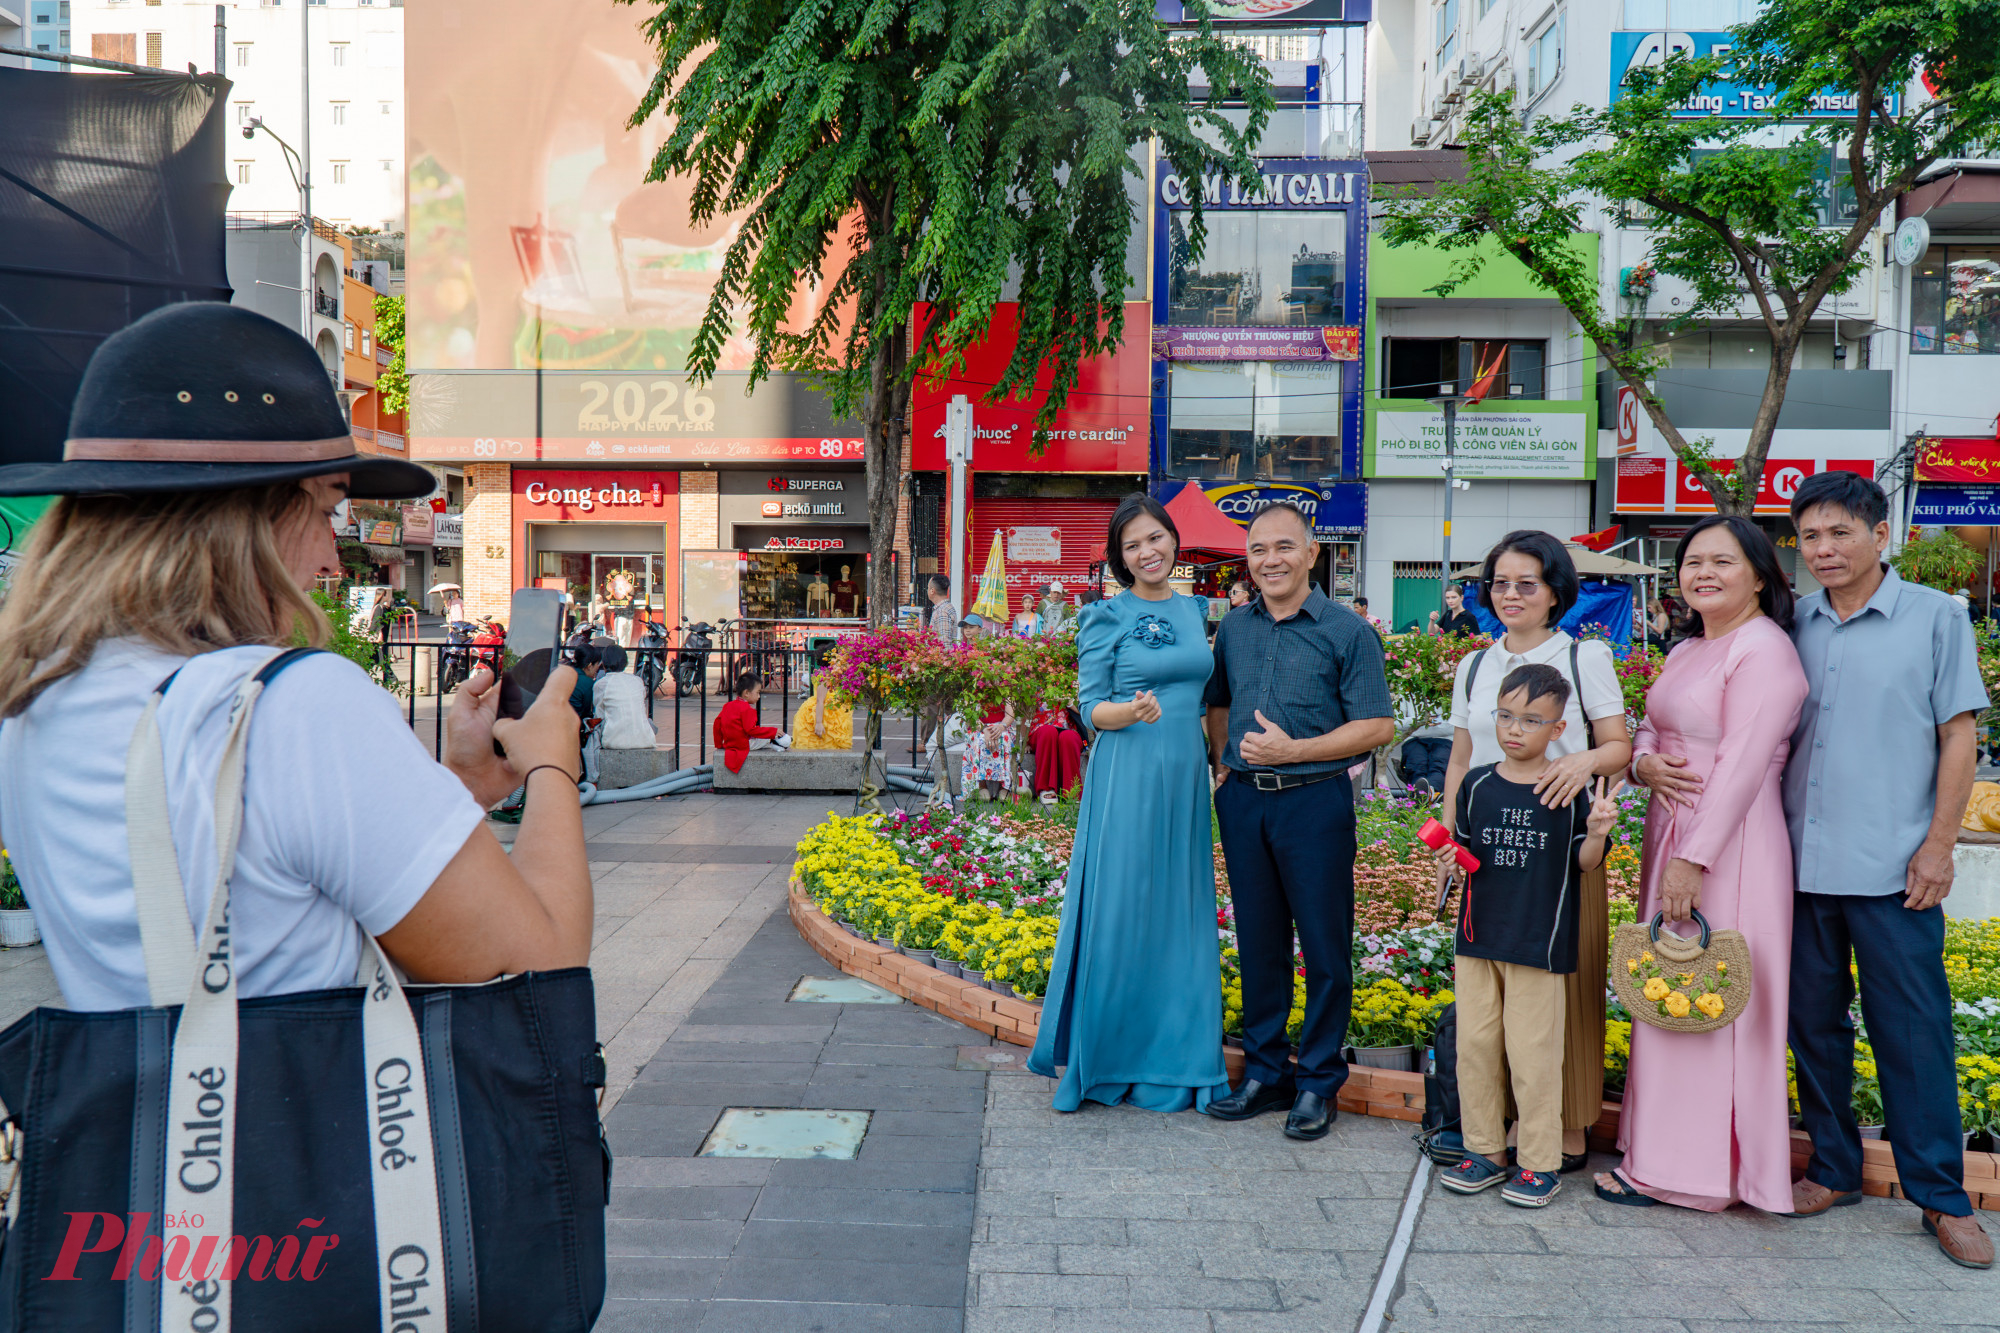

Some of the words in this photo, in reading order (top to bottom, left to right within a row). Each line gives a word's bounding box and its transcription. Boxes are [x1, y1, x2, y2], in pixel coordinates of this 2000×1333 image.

[1740, 91, 1777, 110] Tax
[1287, 173, 1354, 204] CALI
[1182, 332, 1220, 342] NHƯỢNG
[1254, 331, 1291, 341] THƯƠNG
[1293, 330, 1314, 343] HIỆU
[1197, 344, 1230, 358] NGHIỆP
[1301, 347, 1322, 357] CALI
[578, 381, 715, 423] 2026
[1623, 400, 1634, 430] K
[578, 421, 629, 432] HAPPY
[634, 421, 671, 432] NEW
[676, 421, 714, 432] YEAR
[1079, 427, 1127, 440] cardin
[1464, 425, 1488, 436] TÂM
[1491, 425, 1524, 437] QUẢN
[1528, 425, 1542, 437] LÝ
[691, 441, 720, 456] Sale
[1408, 440, 1420, 449] ĐI
[1462, 438, 1496, 450] CÔNG
[1500, 439, 1526, 450] VIÊN
[1529, 439, 1548, 450] SÀI
[1551, 440, 1577, 451] GÒN
[788, 480, 844, 491] SUPERGA
[1782, 474, 1800, 493] K
[525, 482, 593, 511] Gong
[597, 482, 643, 505] cha
[1914, 505, 1943, 515] KHU
[1946, 501, 1976, 515] PHỐ
[786, 537, 844, 550] Kappa
[485, 545, 505, 559] 52
[1030, 572, 1069, 585] pierre
[1501, 808, 1533, 826] THE
[1482, 828, 1548, 850] STREET
[1494, 848, 1528, 868] BOY
[374, 1057, 417, 1171] Chloé
[178, 1066, 226, 1193] Chloé
